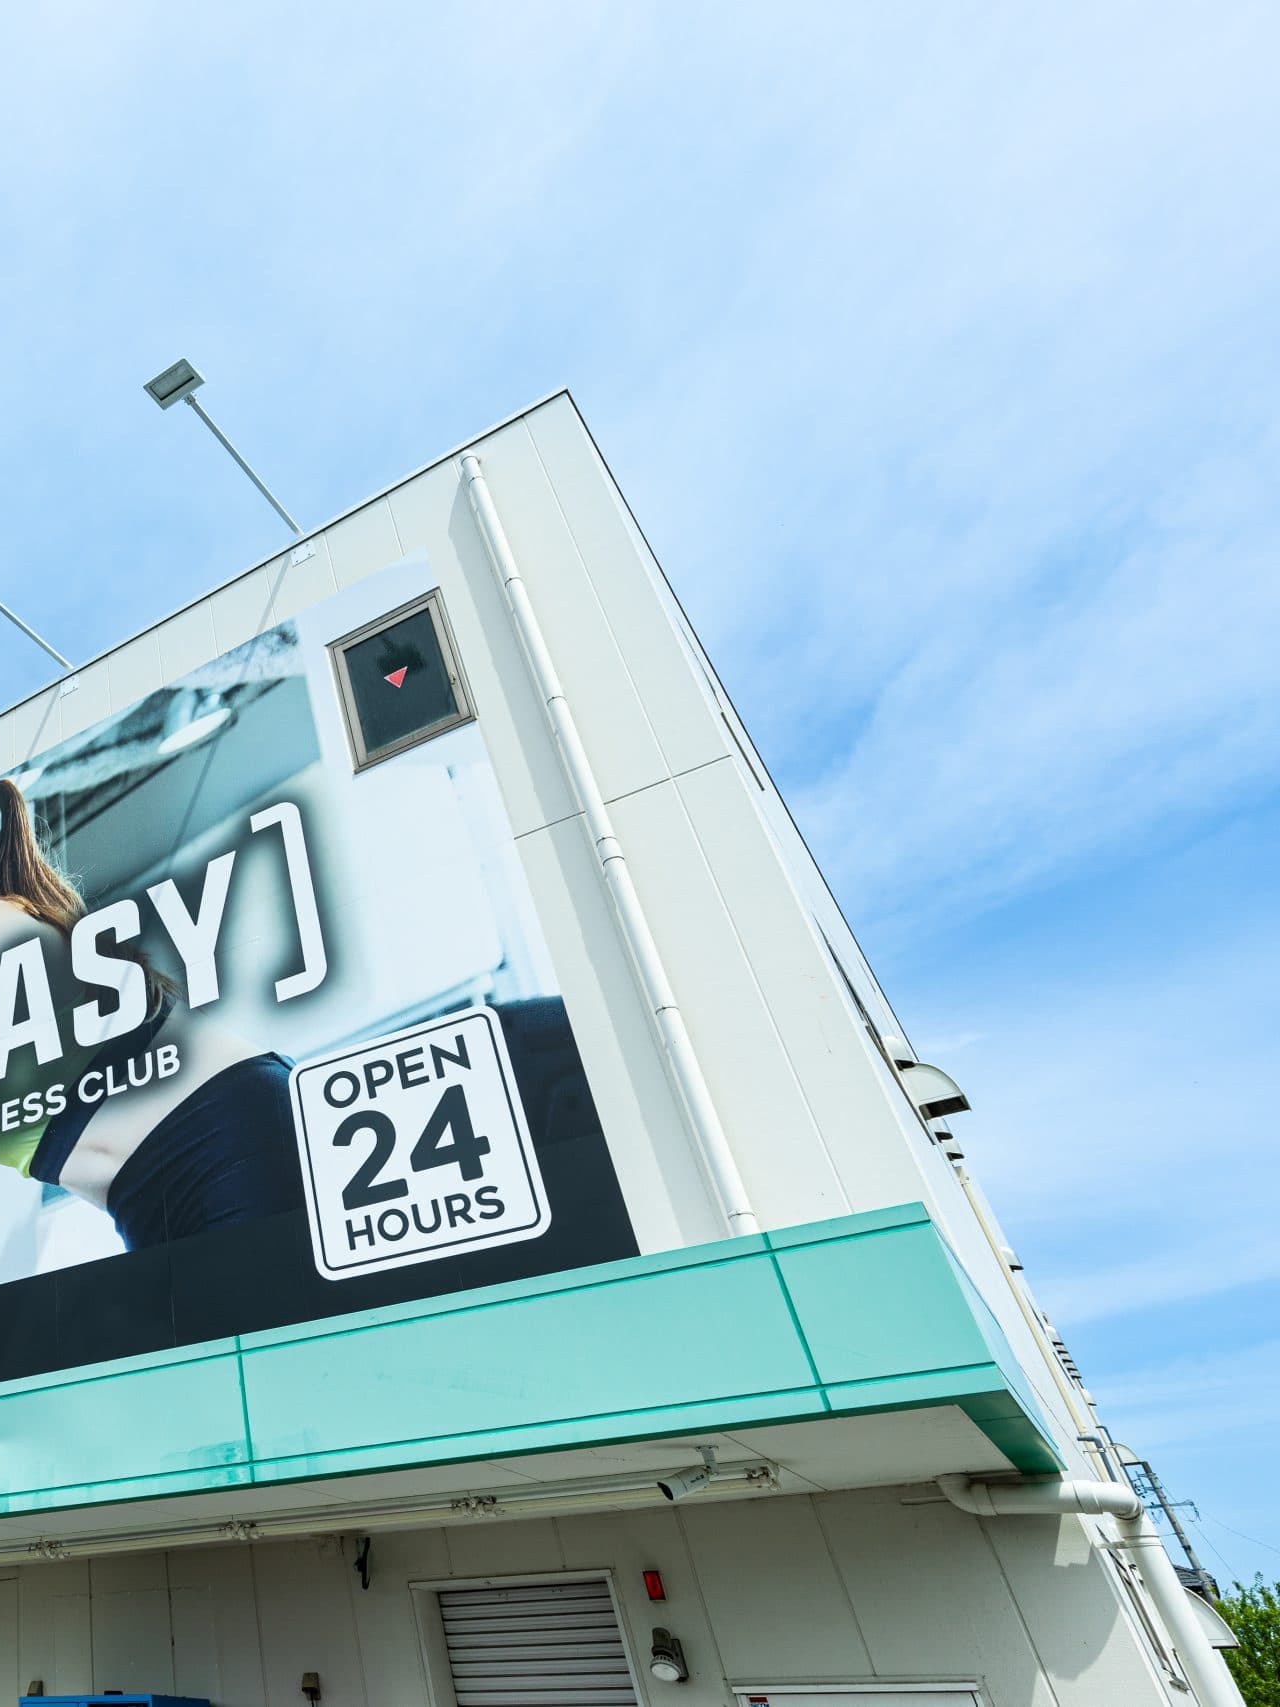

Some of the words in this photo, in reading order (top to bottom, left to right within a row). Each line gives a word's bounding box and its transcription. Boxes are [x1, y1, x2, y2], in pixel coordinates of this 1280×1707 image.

[77, 1043, 181, 1104] CLUB
[323, 1034, 472, 1109] OPEN
[332, 1083, 491, 1211] 24
[345, 1185, 505, 1251] HOURS
